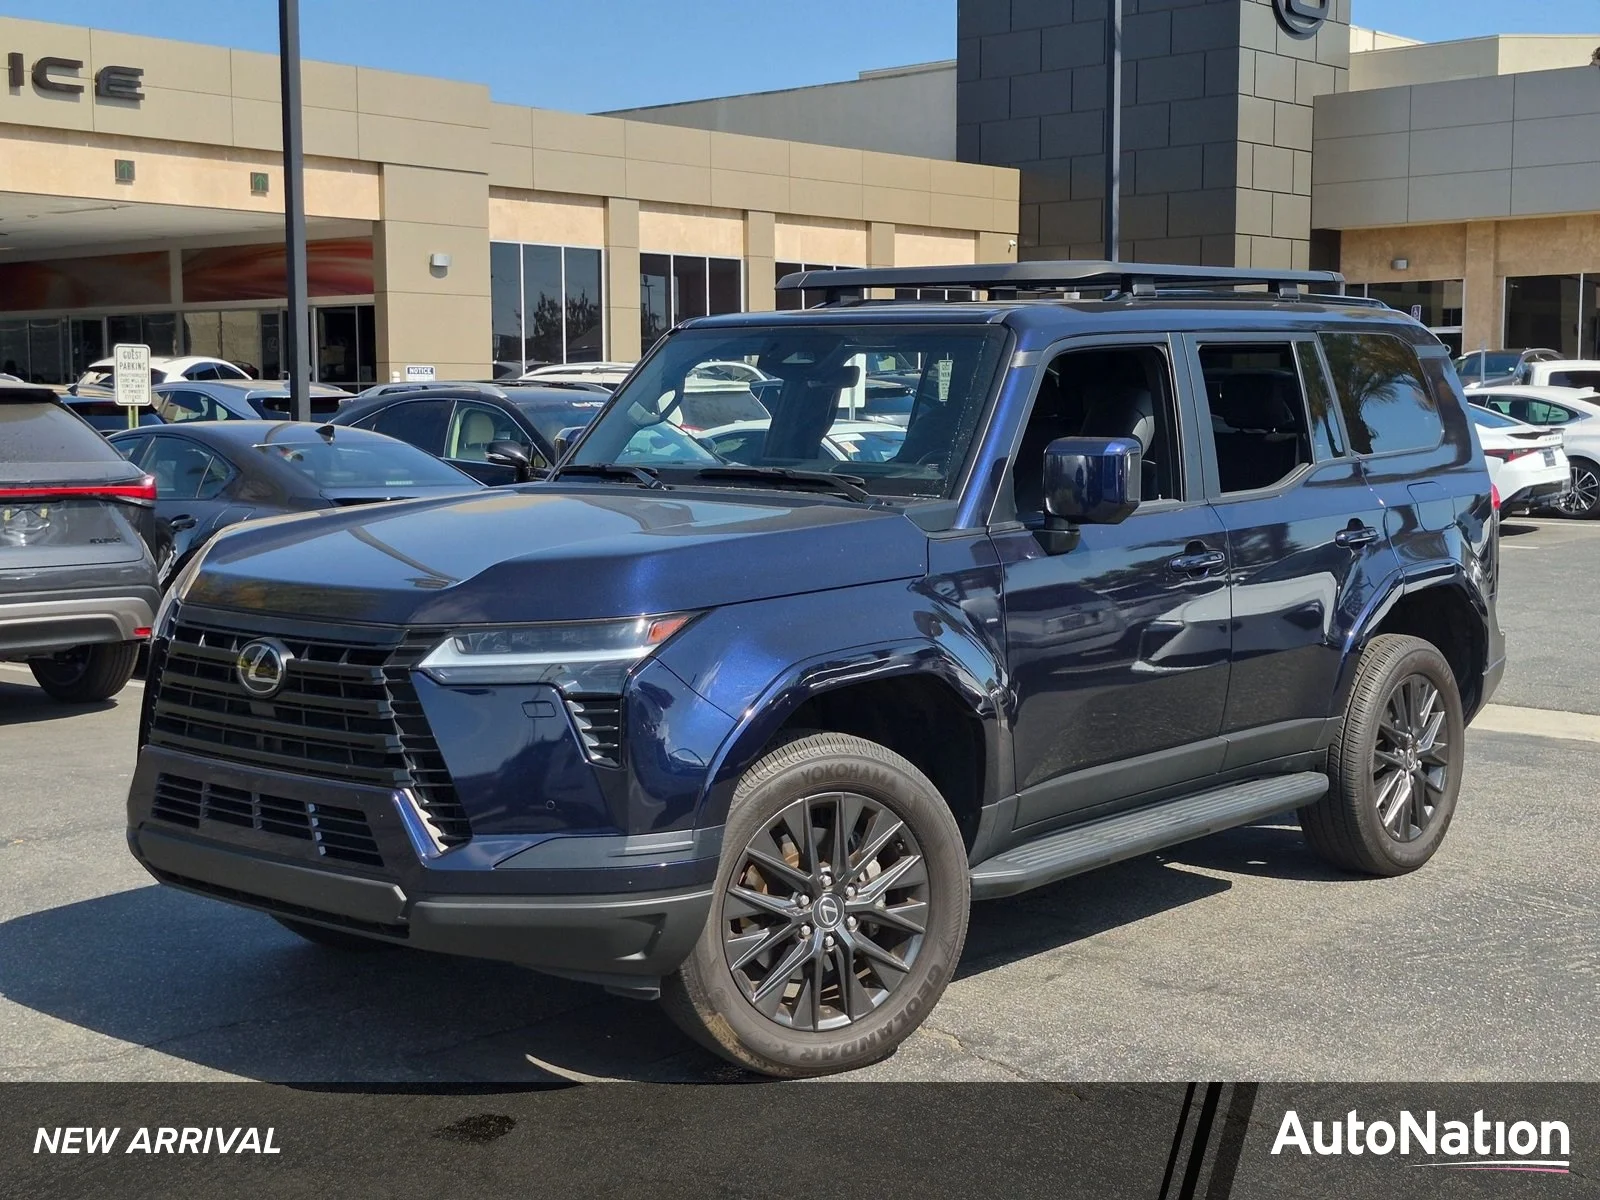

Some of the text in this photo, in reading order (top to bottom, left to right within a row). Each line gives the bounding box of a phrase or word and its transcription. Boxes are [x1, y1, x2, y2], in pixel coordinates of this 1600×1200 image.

[123, 351, 142, 360] GUEST
[119, 361, 146, 371] PARKING
[800, 763, 898, 792] YOKOHAMA
[800, 963, 943, 1061] GEOLANDAR
